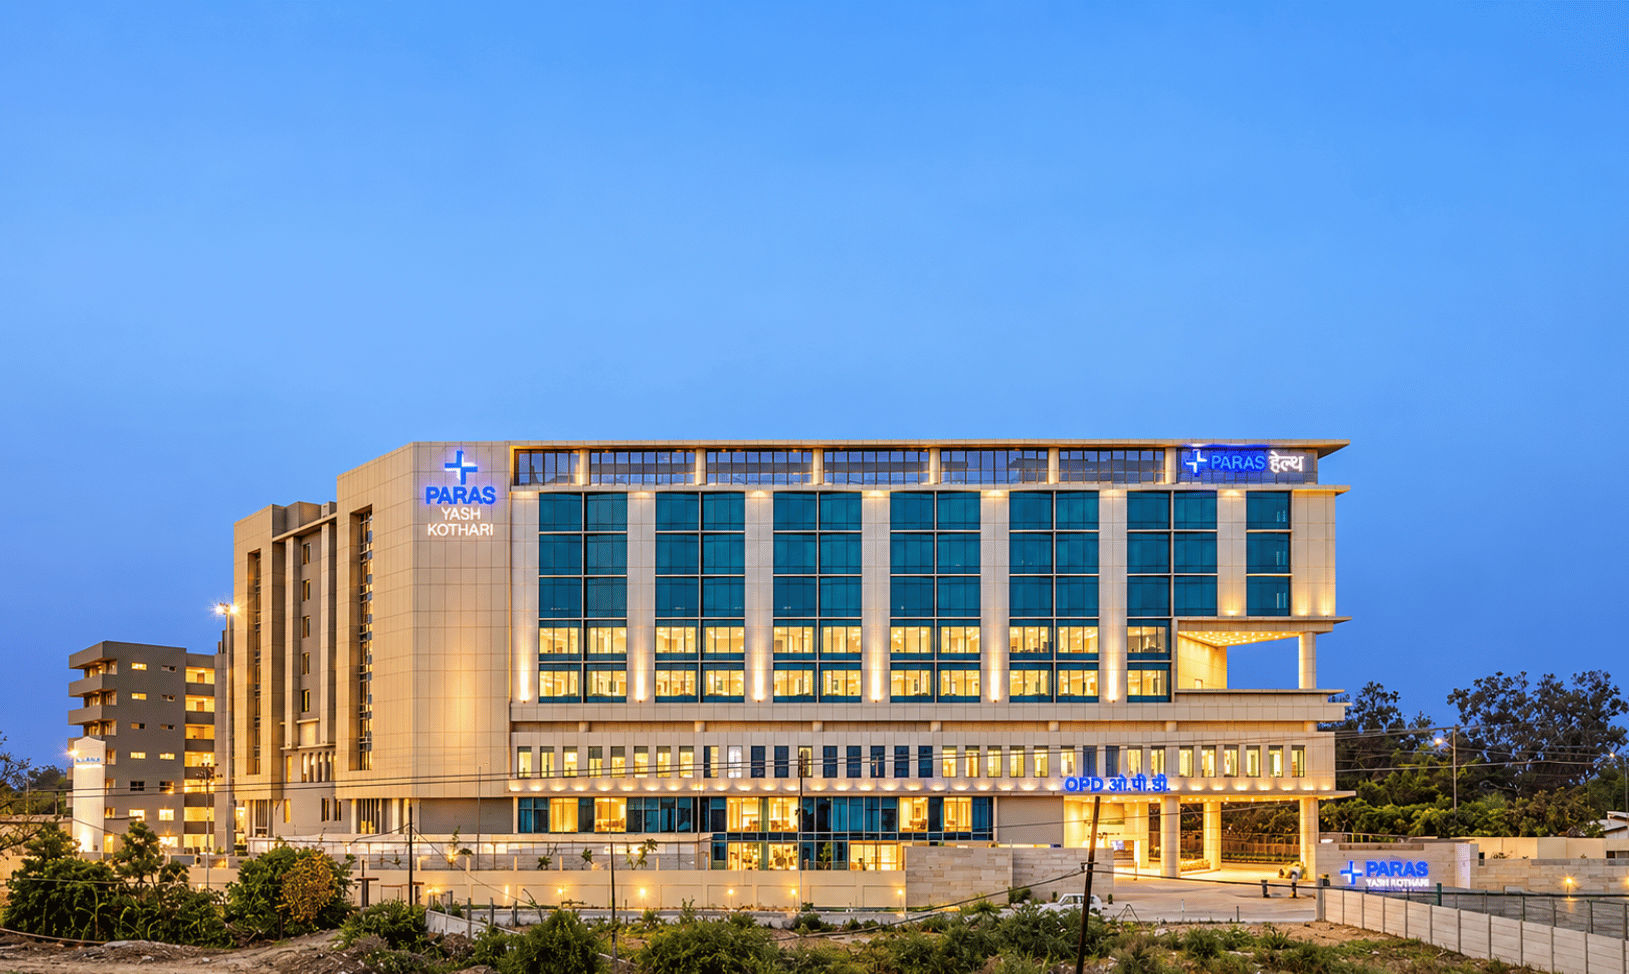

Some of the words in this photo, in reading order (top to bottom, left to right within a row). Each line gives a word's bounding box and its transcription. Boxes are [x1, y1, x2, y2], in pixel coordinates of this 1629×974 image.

[1211, 454, 1265, 470] PARAS
[1268, 450, 1304, 473] हेल्थ
[425, 486, 496, 505] PARAS
[441, 507, 481, 520] YASH
[427, 523, 494, 536] KOTHARI
[1065, 776, 1104, 792] OPD
[1365, 861, 1429, 877] PARAS
